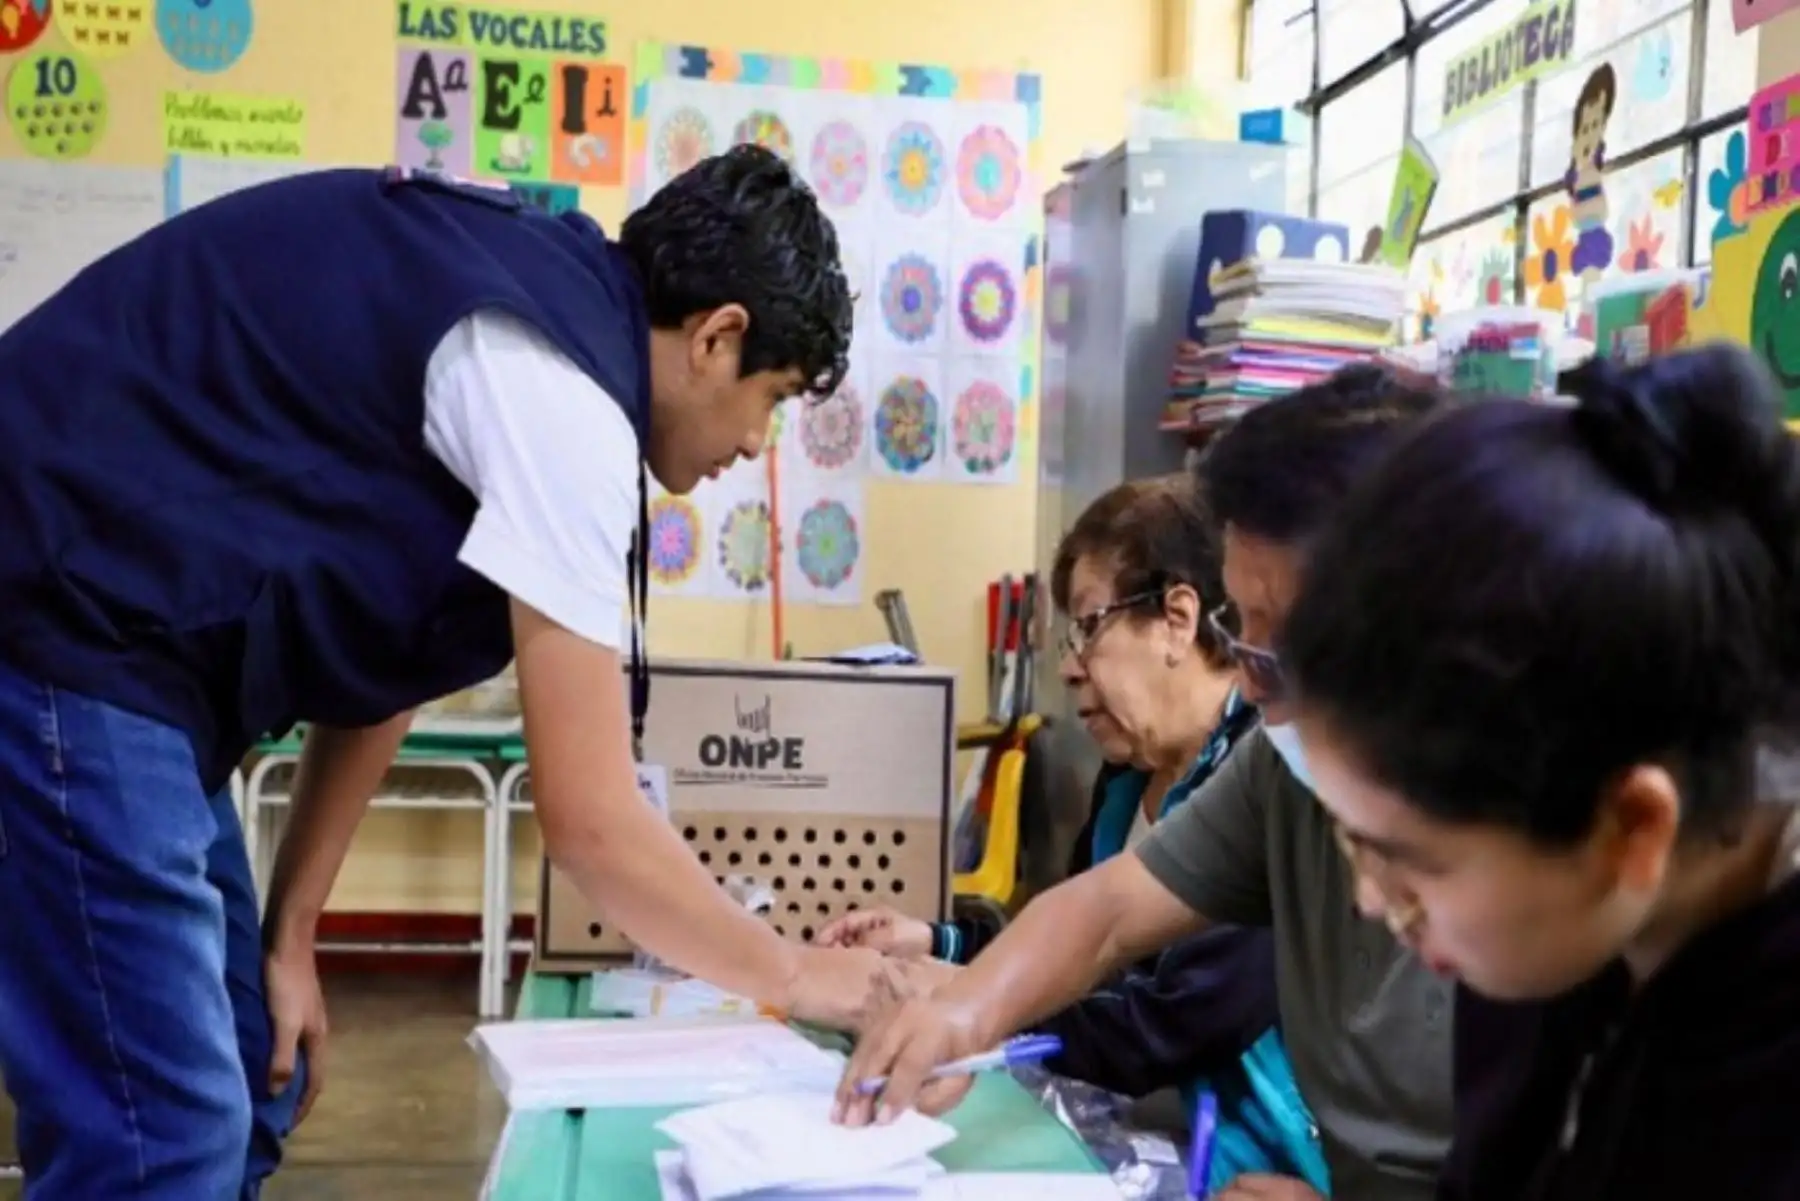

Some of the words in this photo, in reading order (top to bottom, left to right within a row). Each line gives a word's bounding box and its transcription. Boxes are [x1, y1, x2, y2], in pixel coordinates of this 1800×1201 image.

[398, 3, 457, 38] LAS
[469, 11, 606, 54] VOCALES
[35, 56, 77, 97] 10
[1443, 0, 1576, 116] BIBLIOTECA
[699, 734, 804, 769] ONPE
